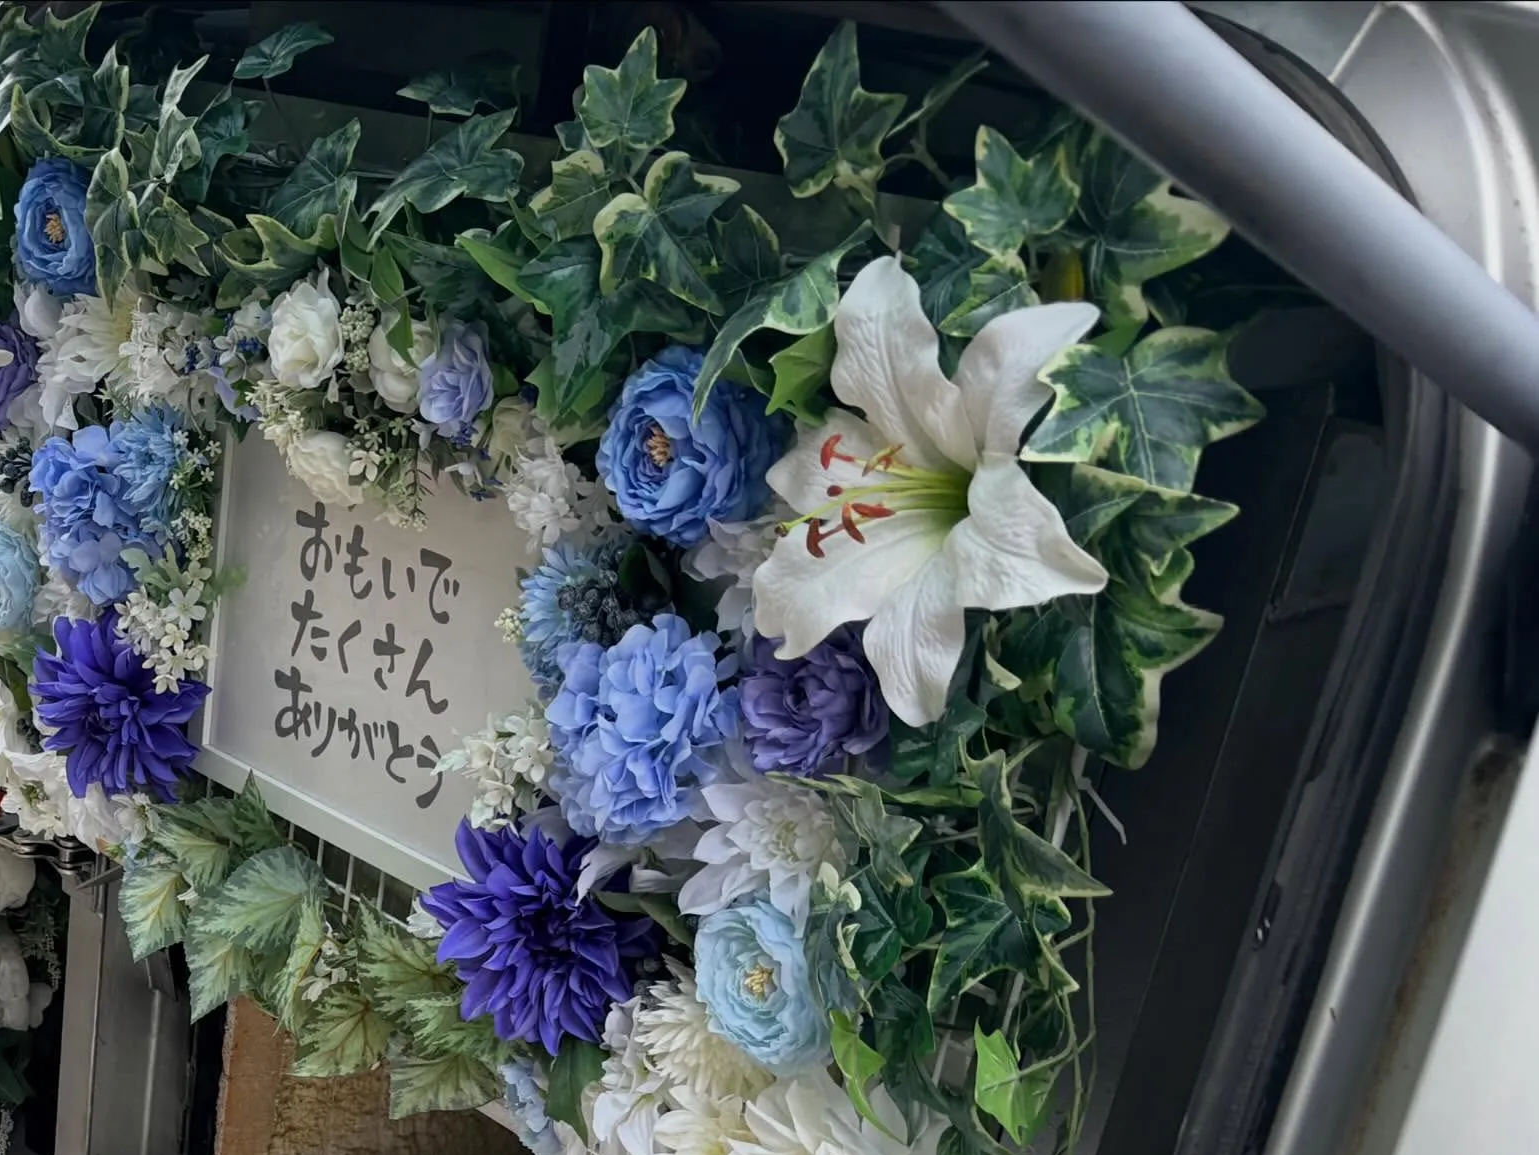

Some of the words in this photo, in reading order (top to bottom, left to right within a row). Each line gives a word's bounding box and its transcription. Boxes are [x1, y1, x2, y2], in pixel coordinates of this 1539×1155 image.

[295, 501, 460, 625] おもいで
[290, 589, 449, 715] たくさん
[273, 666, 444, 810] ありがとう
